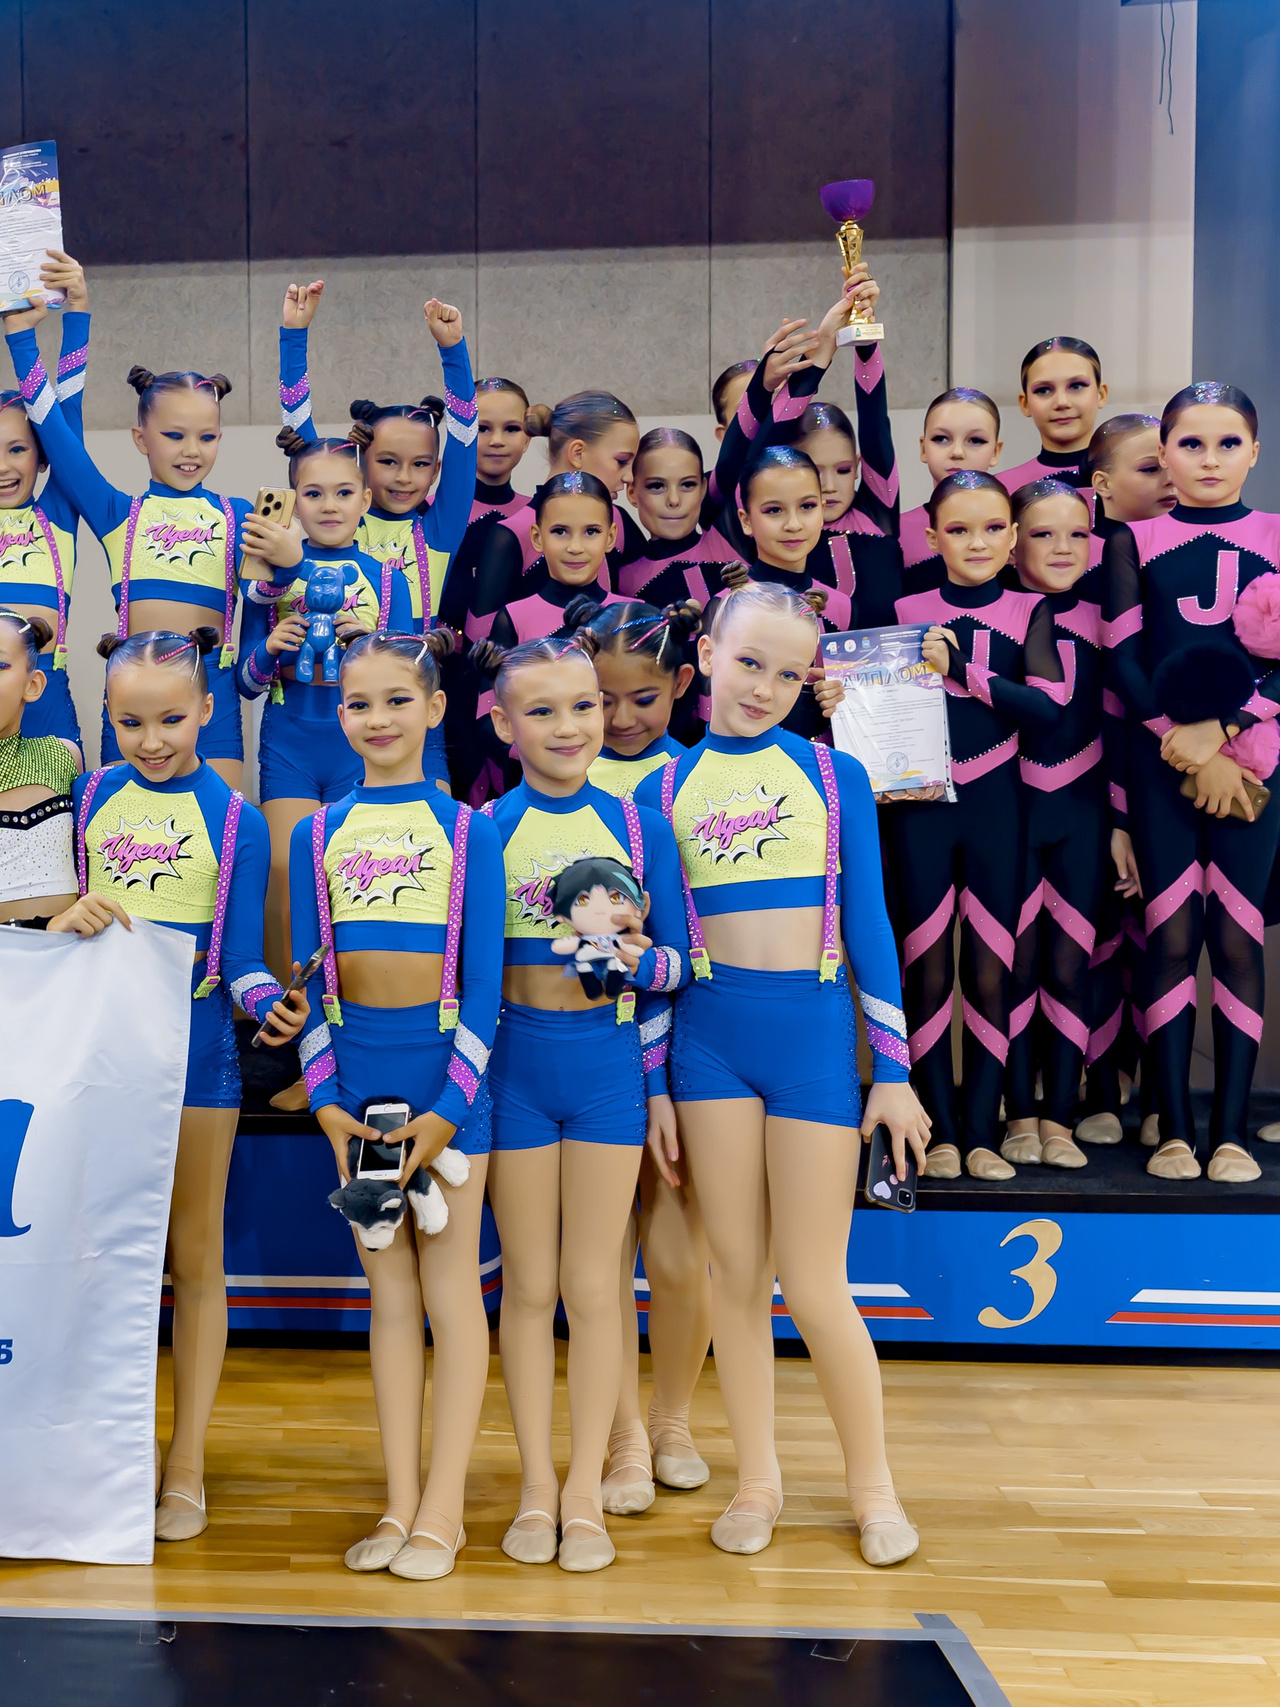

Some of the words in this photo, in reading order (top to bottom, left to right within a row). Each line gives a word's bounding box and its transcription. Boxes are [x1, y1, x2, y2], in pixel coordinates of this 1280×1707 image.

[146, 524, 215, 551] Идеал
[1177, 549, 1240, 626] J
[842, 664, 927, 691] ДИПЛОМ
[693, 806, 781, 850] Идеал
[101, 833, 182, 873] Идеал
[338, 850, 423, 891] Идеал
[977, 1218, 1063, 1329] 3
